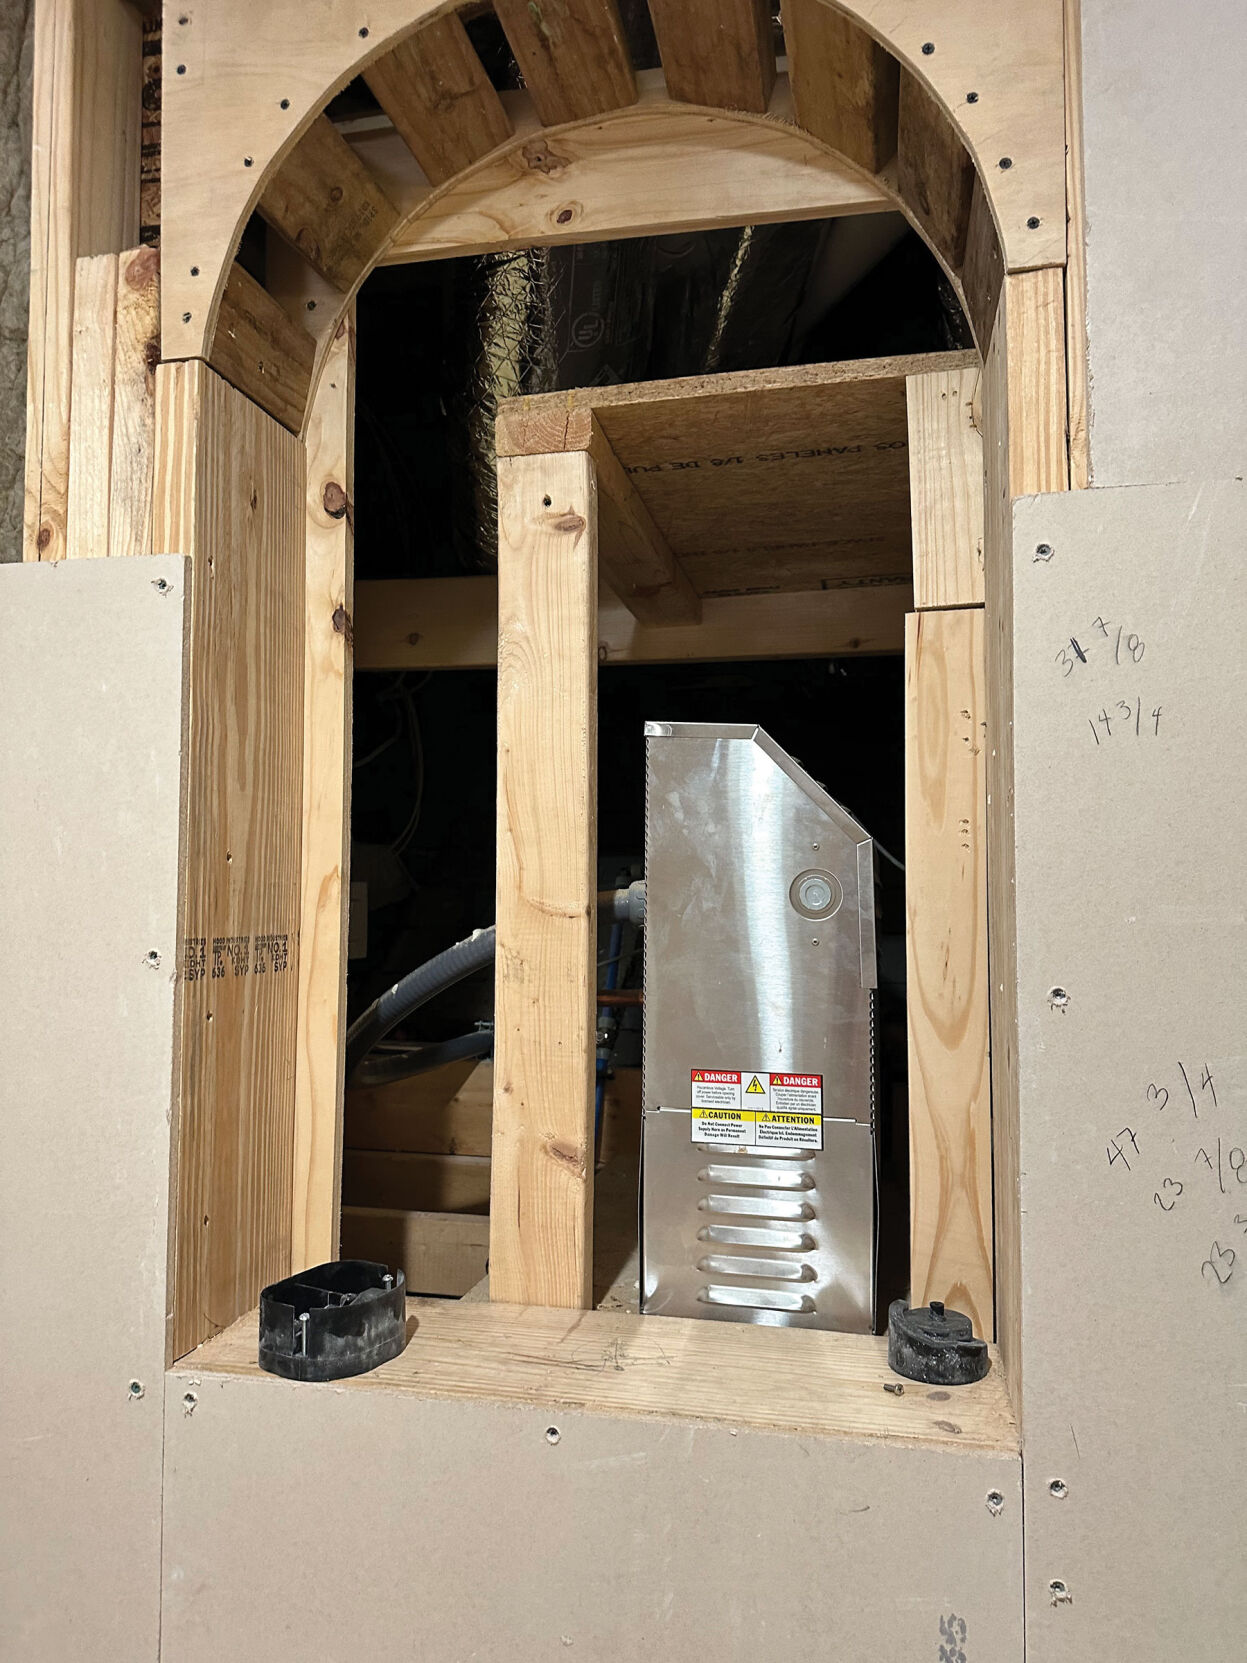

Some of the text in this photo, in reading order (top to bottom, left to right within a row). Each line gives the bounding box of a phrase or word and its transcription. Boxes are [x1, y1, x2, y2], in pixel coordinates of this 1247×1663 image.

[757, 444, 862, 462] PANELES
[669, 461, 700, 470] DE
[274, 961, 288, 972] SYP
[704, 1073, 738, 1083] DANGER
[783, 1076, 819, 1086] DANGER
[708, 1111, 742, 1120] CAUTION
[772, 1115, 815, 1124] ATTENTION
